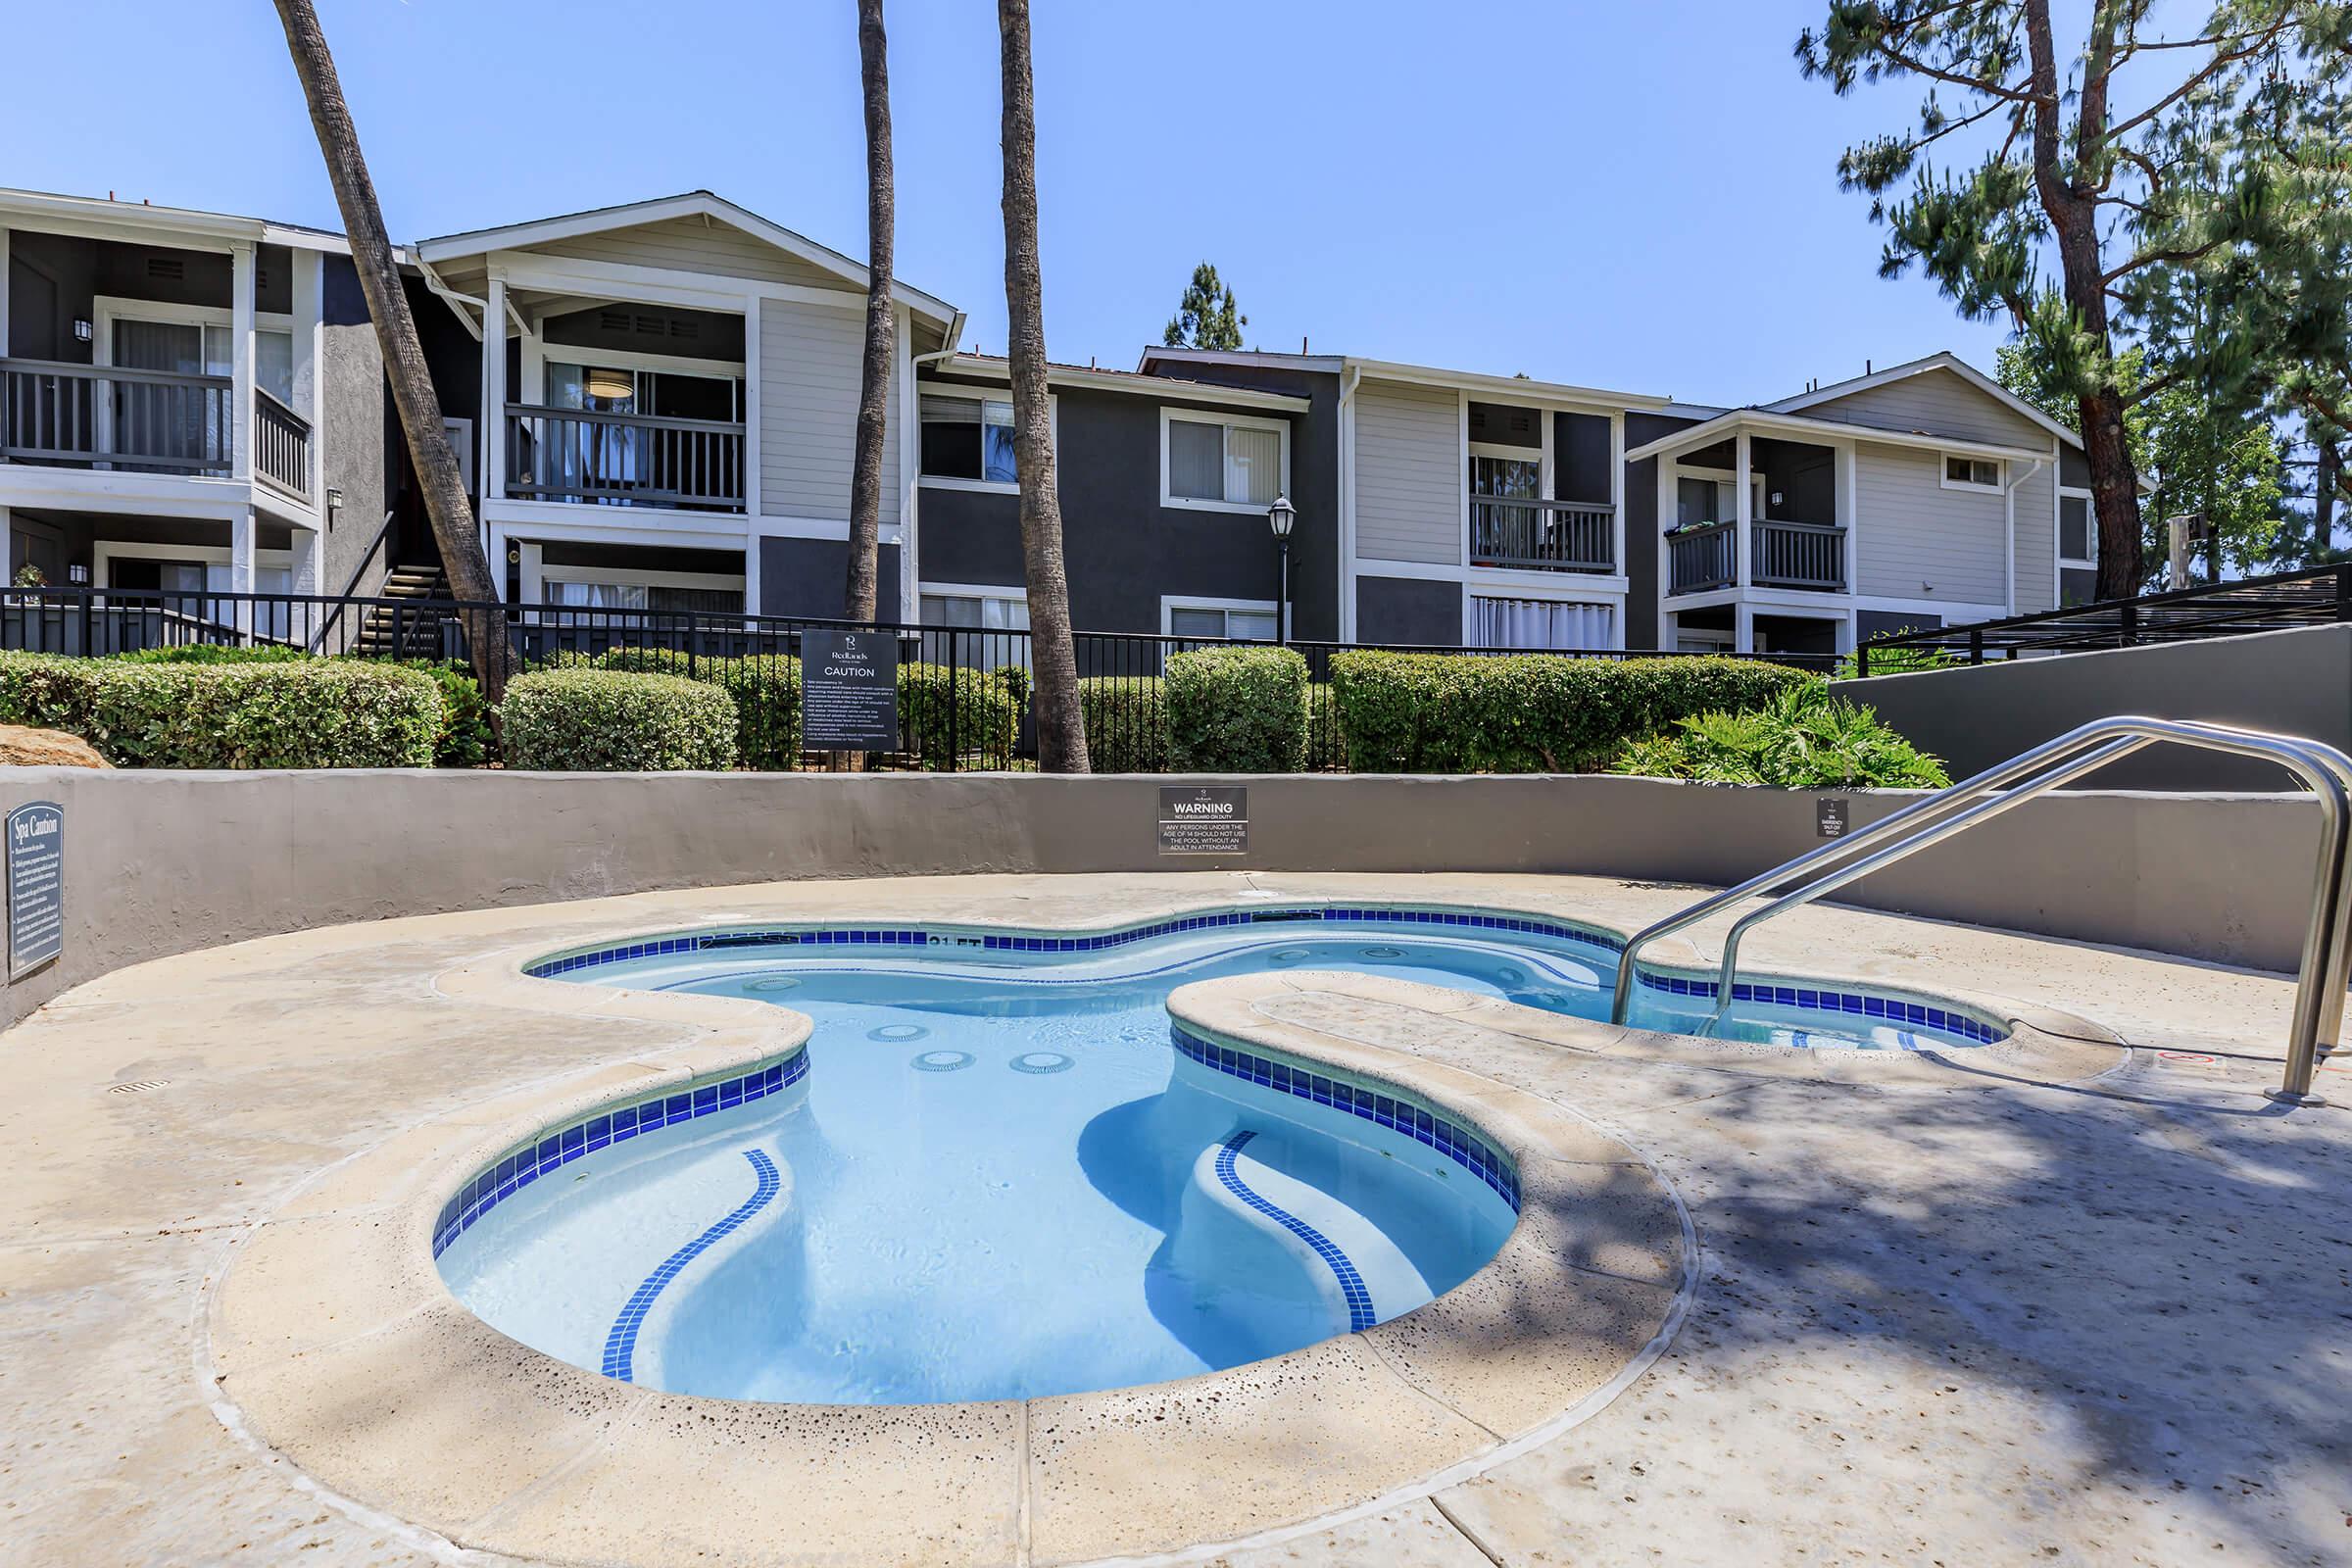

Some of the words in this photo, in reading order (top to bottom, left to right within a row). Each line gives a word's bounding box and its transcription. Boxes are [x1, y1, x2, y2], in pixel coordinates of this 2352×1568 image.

[824, 667, 875, 677] CAUTION
[1174, 803, 1233, 813] WARNING
[15, 817, 29, 845] Spa
[30, 813, 57, 836] Caution
